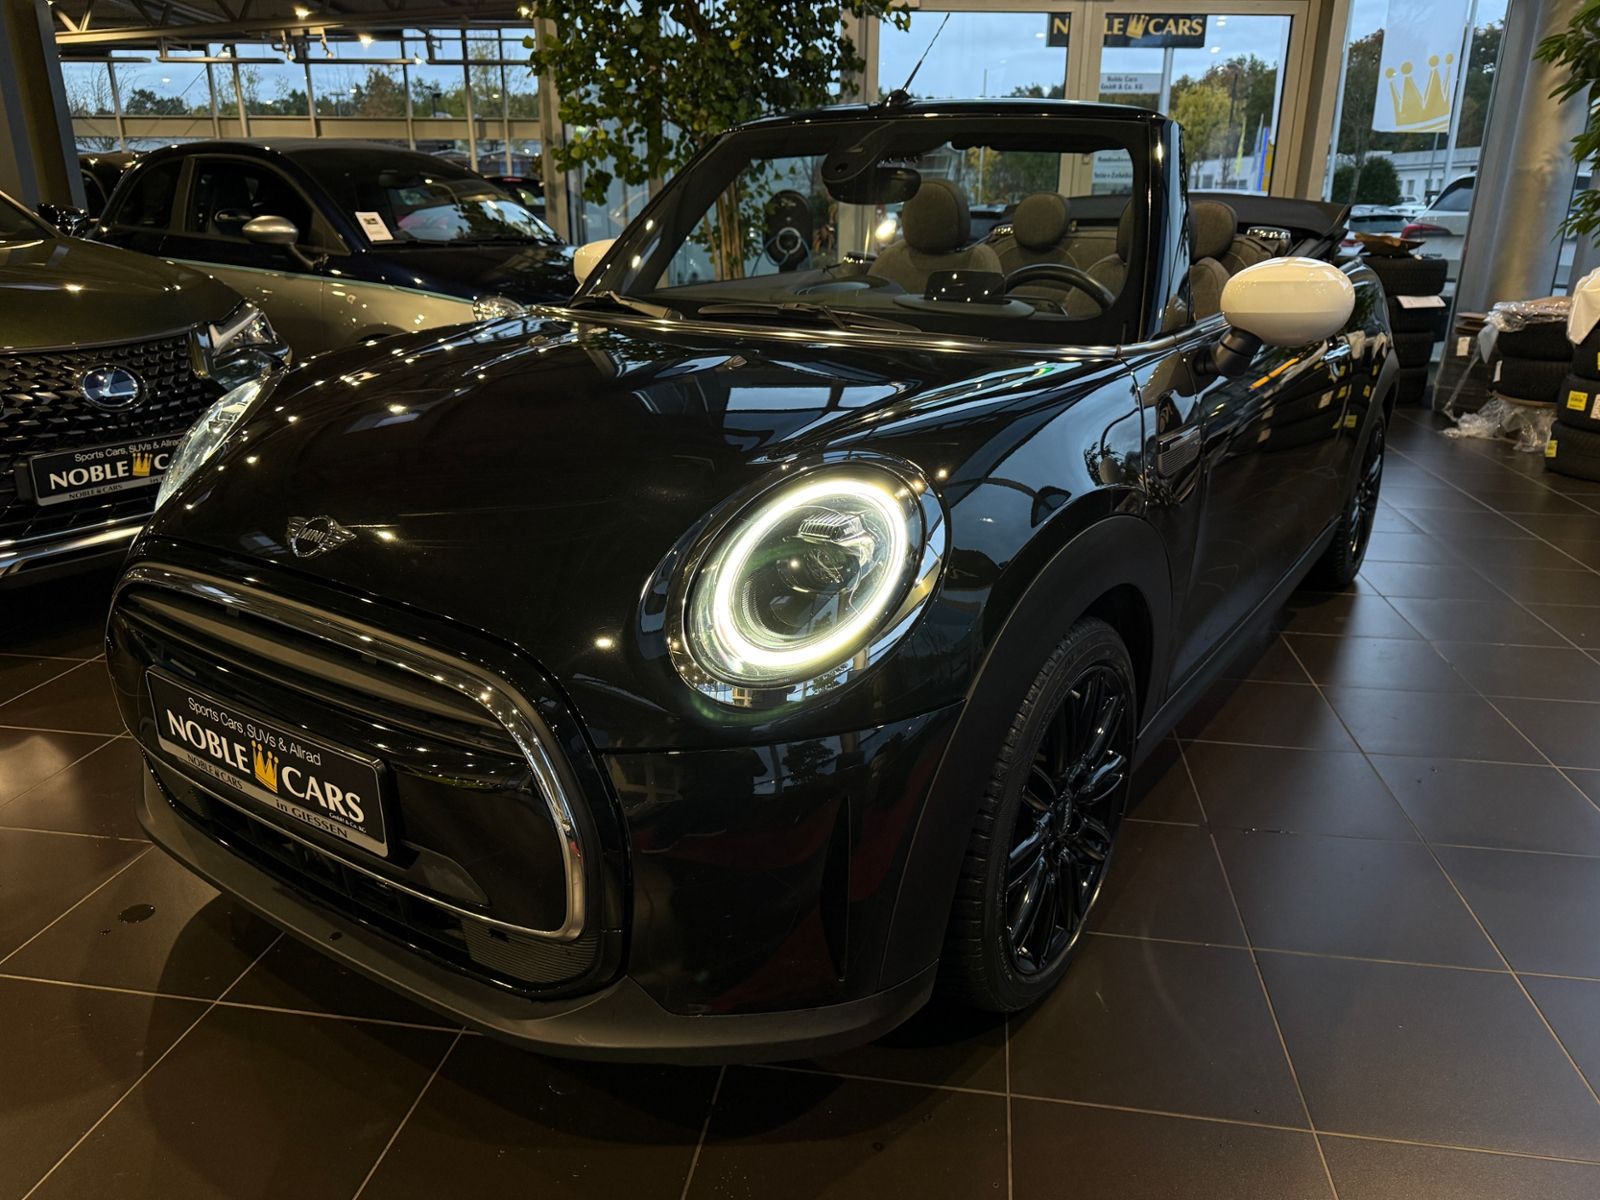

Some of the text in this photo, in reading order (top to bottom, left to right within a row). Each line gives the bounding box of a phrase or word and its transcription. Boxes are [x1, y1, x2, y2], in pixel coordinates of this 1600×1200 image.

[1148, 17, 1203, 36] CARS
[75, 452, 104, 463] Sports
[105, 447, 127, 458] Cars,
[129, 443, 152, 453] SUVs
[153, 441, 160, 449] &
[50, 461, 130, 490] NOBLE
[69, 484, 122, 499] NOBLE CARS
[188, 697, 321, 766] Sports Cars, SUVs & Allrad
[167, 709, 365, 823] NOBLE CARS
[187, 753, 243, 790] NOBLE CARS
[276, 799, 348, 838] in GIESSEN
